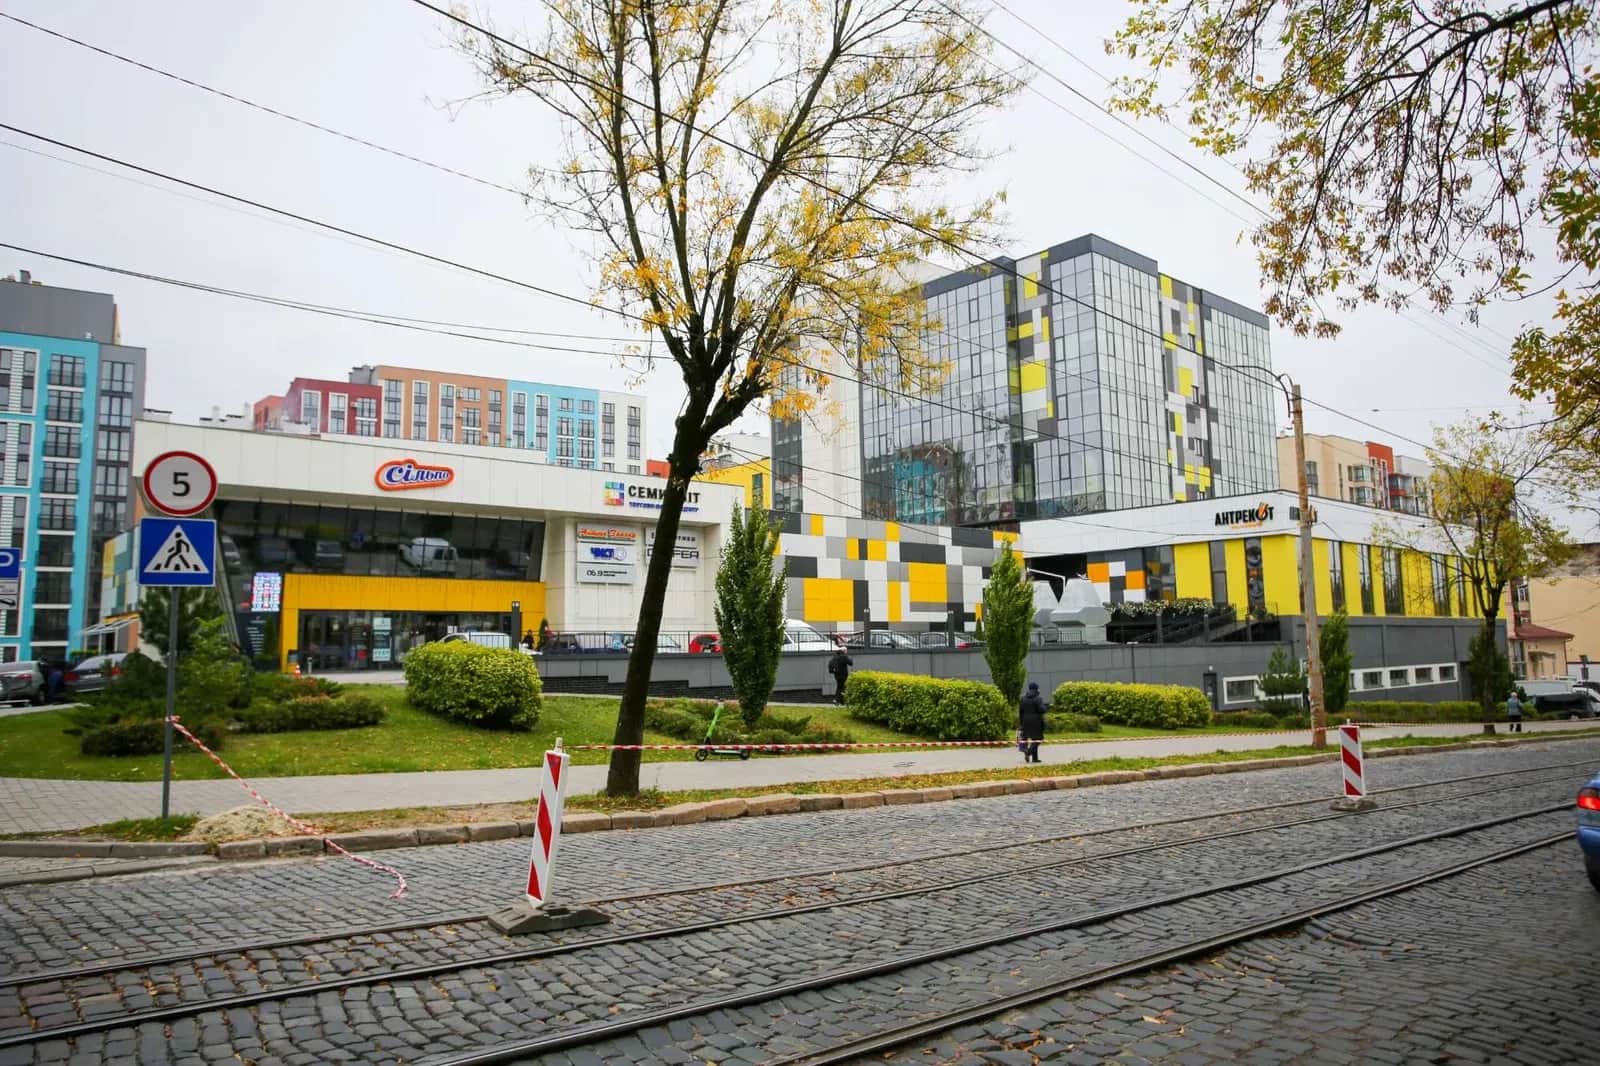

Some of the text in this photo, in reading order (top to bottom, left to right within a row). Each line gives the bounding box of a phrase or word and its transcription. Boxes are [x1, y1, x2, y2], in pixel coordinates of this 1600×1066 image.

[172, 471, 190, 496] 5
[385, 463, 449, 483] Сільпо
[628, 485, 701, 503] СЕМИІТ
[1215, 503, 1274, 526] АНТРЕКОТ
